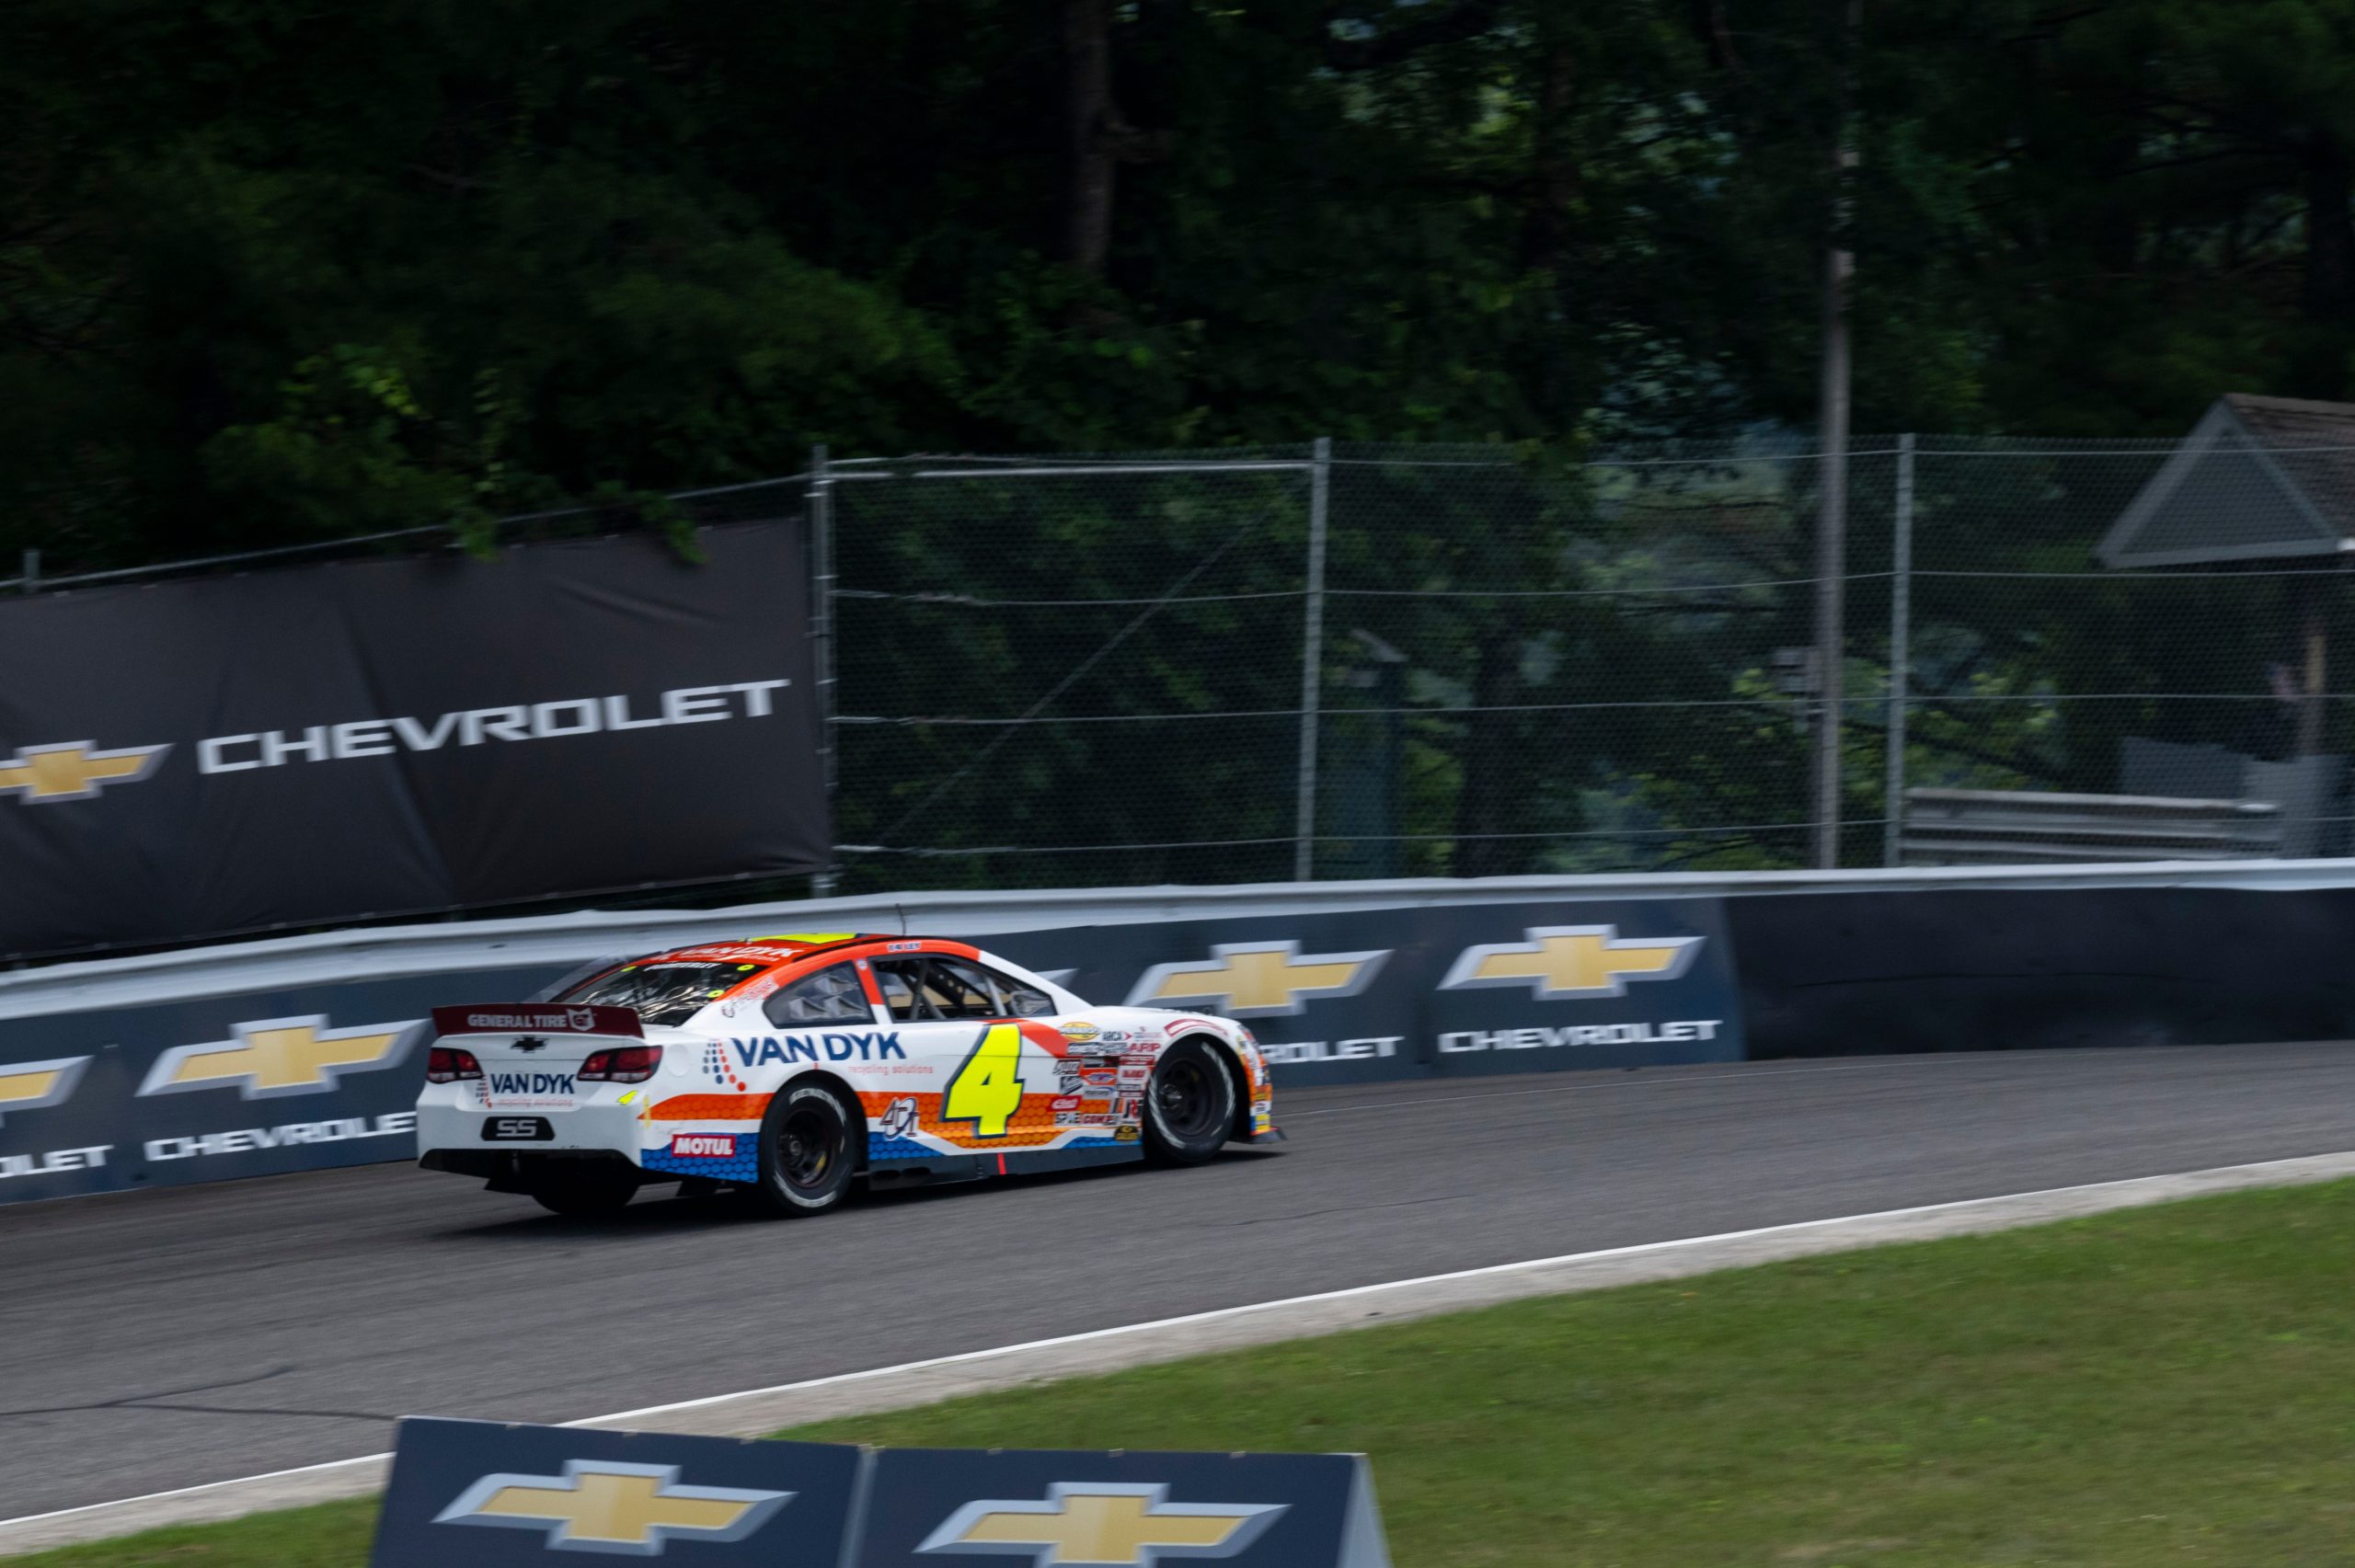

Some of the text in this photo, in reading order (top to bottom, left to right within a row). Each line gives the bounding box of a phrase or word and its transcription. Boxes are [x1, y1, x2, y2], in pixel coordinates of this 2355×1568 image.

[196, 679, 792, 775] CHEVROLET
[467, 1013, 568, 1027] GENERAL TIRE
[1437, 1019, 1724, 1053] CHEVROLET
[730, 1031, 906, 1067] VAN DYK
[892, 1064, 935, 1074] solutions
[490, 1073, 575, 1093] VAN DYK
[938, 1023, 1025, 1140] 4
[496, 1119, 538, 1138] SS
[673, 1137, 733, 1155] MOTUL
